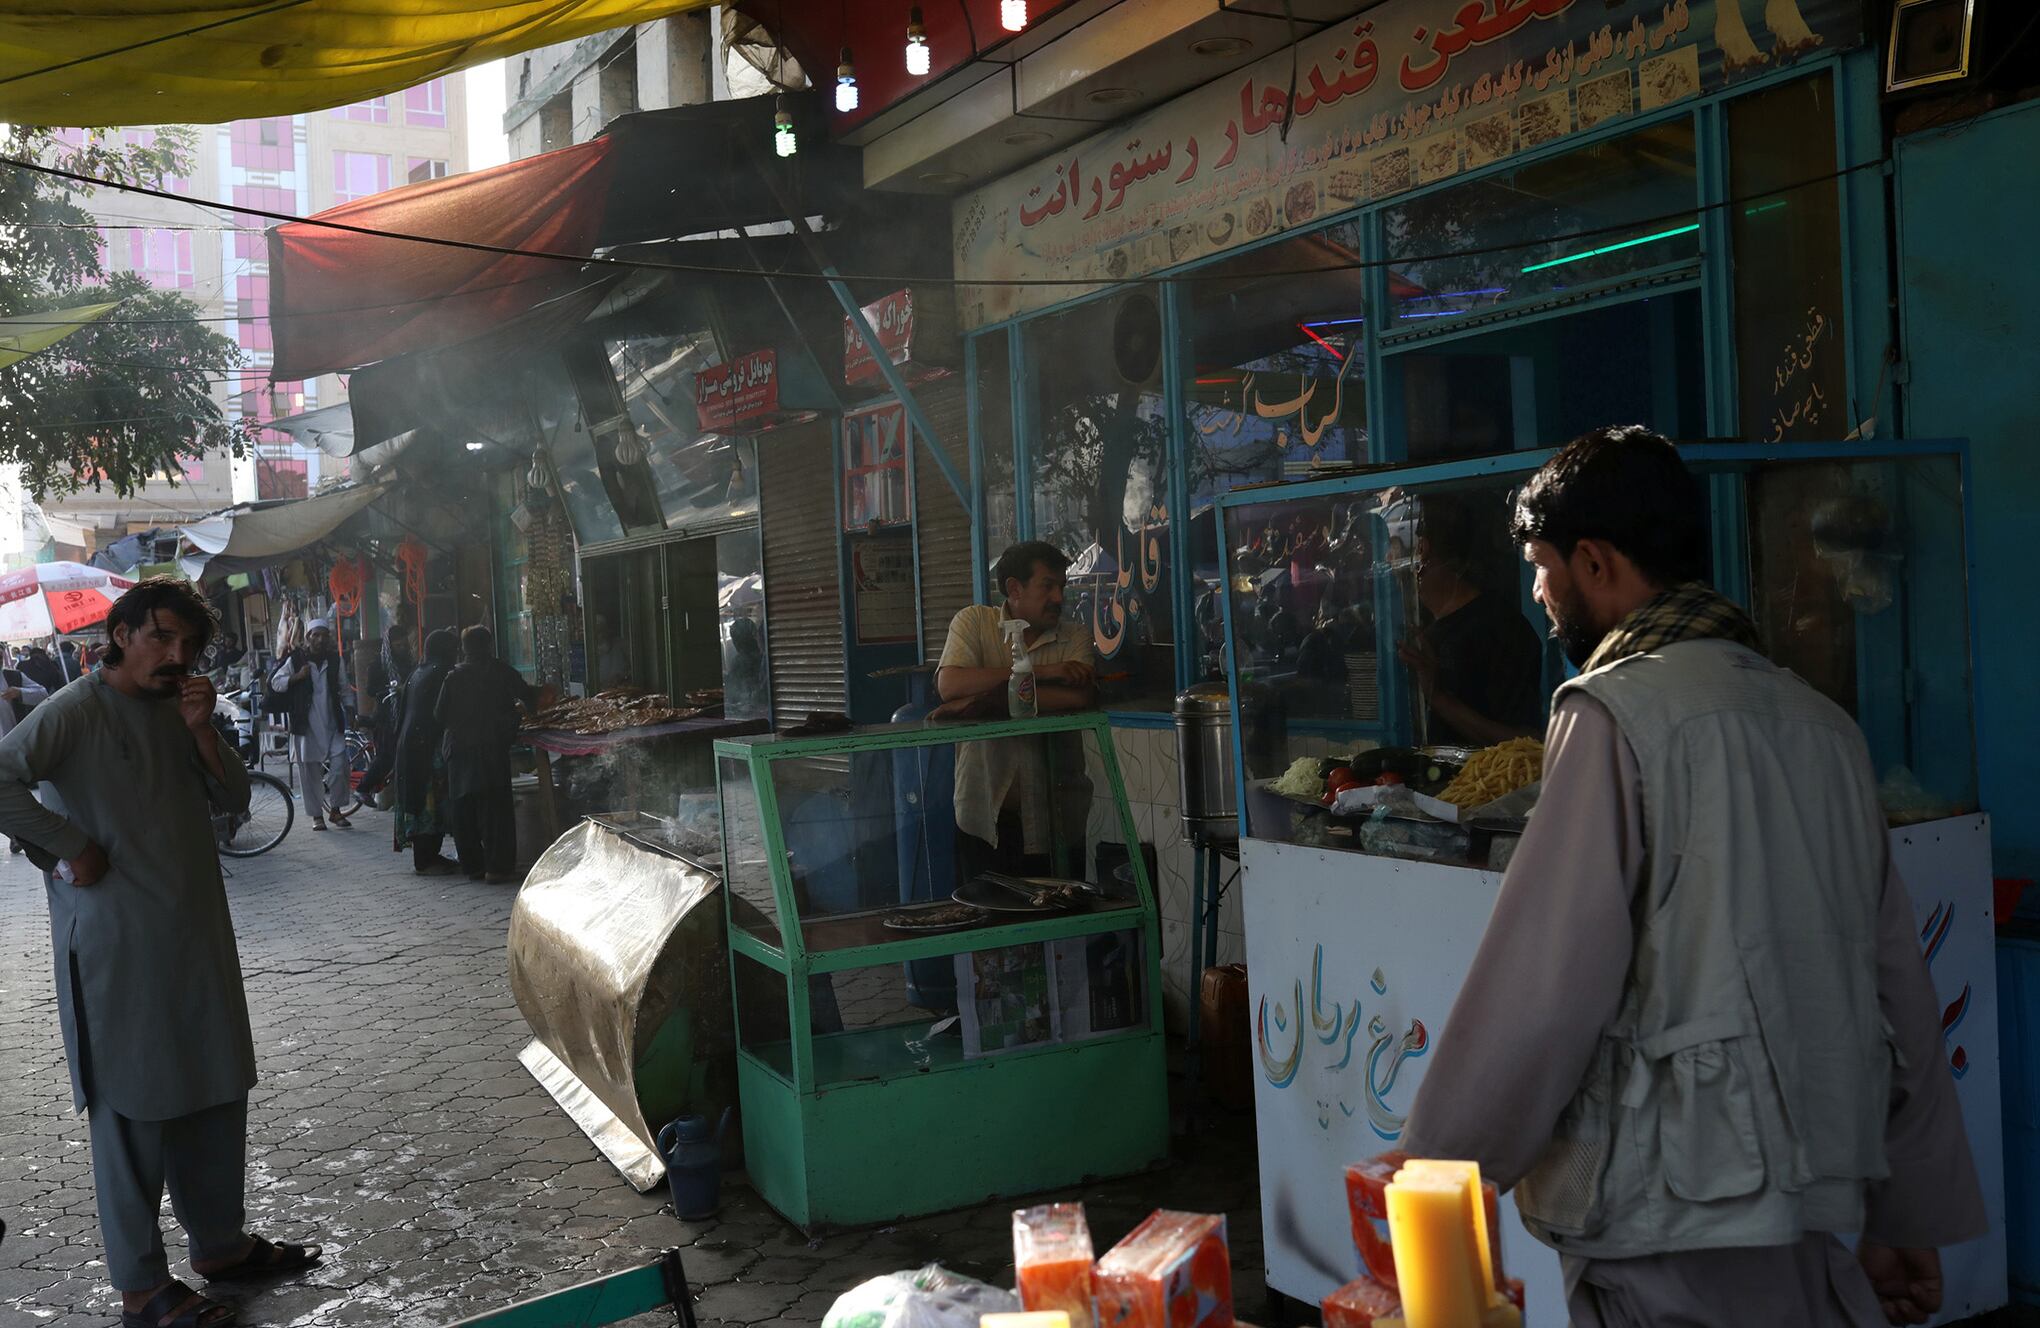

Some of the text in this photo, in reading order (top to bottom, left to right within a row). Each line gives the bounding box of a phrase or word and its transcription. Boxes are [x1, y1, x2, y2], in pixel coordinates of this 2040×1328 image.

[1214, 20, 1379, 171] قندهار
[1019, 135, 1199, 227] رستورانت
[698, 376, 718, 405] مزار
[720, 360, 745, 396] فروشی
[747, 356, 773, 387] موبایل
[1255, 344, 1357, 467] کباب
[1257, 943, 1429, 1141] مرغ بریان
